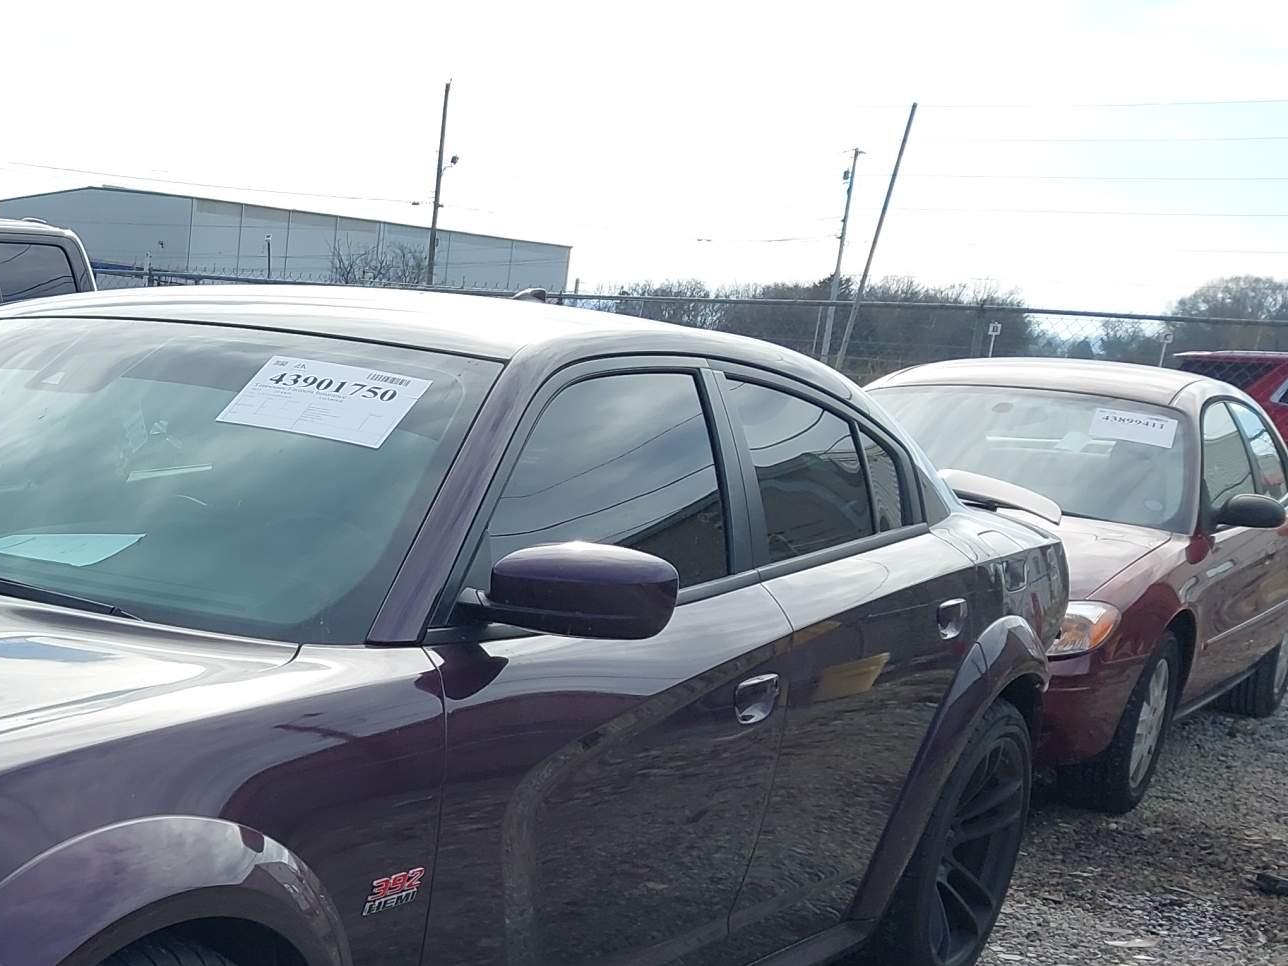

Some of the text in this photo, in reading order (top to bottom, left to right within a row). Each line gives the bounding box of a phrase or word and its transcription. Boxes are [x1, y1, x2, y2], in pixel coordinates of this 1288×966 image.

[269, 372, 398, 402] 43901750
[367, 867, 425, 901] 392
[362, 888, 418, 916] HEMI
